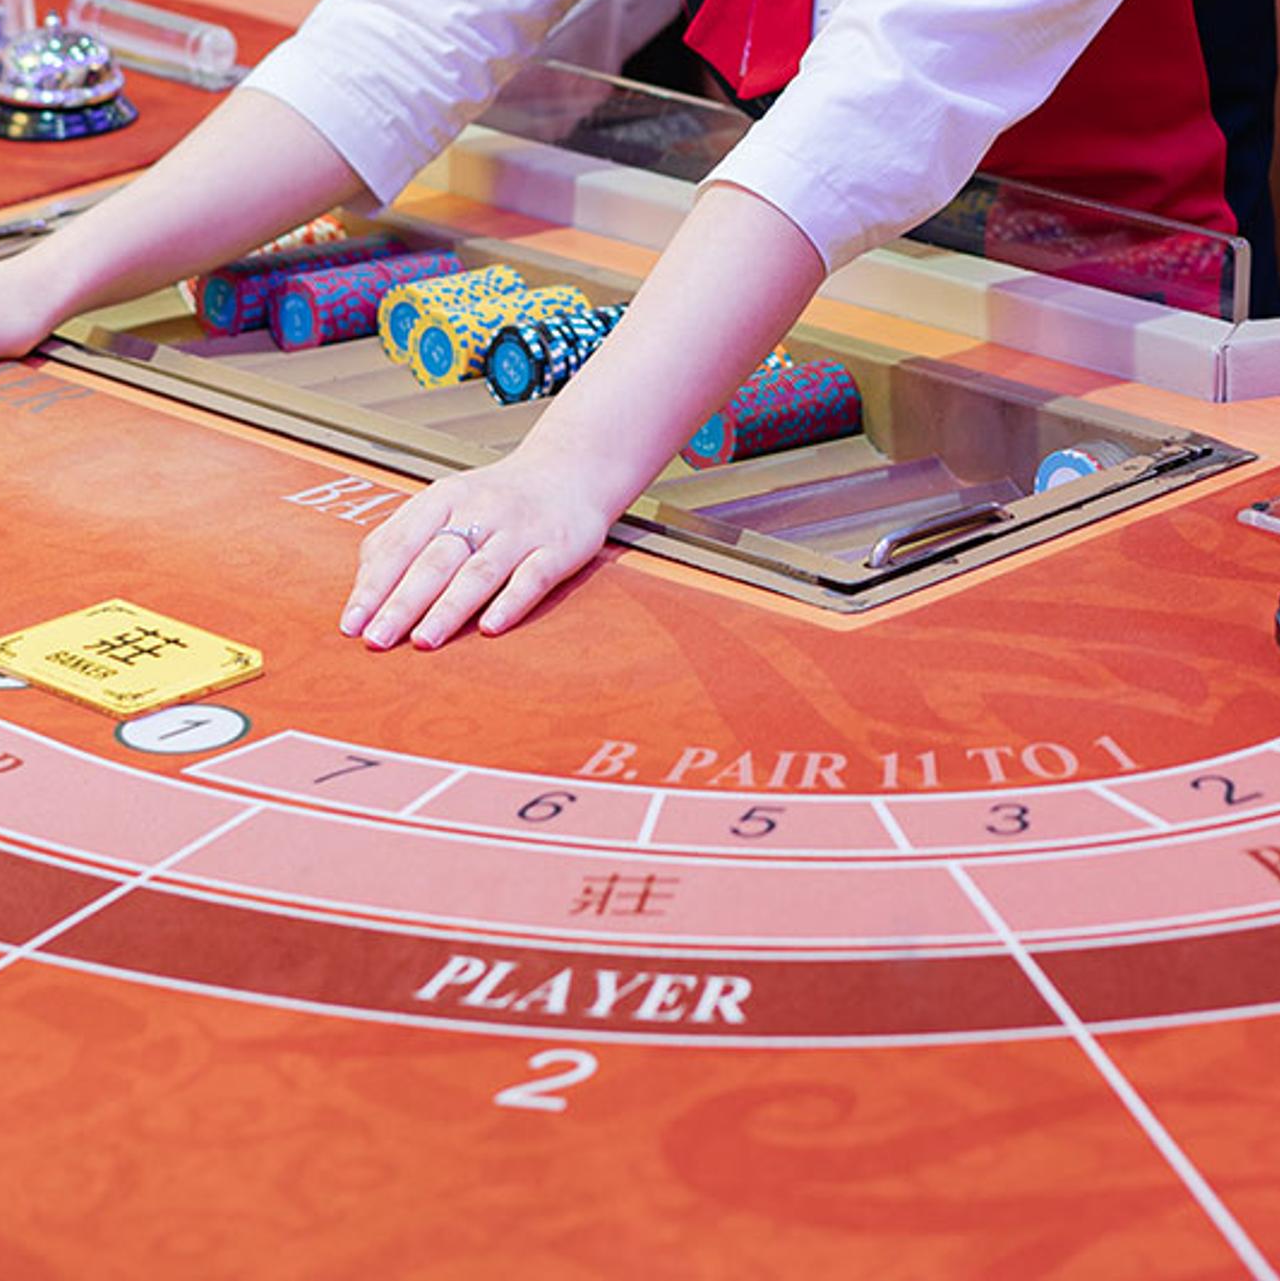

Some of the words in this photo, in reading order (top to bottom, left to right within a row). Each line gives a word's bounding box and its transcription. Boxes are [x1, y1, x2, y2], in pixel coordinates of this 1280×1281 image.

[82, 626, 189, 666] 莊
[45, 651, 118, 681] BANKER
[158, 719, 213, 741] 1
[313, 754, 381, 785] 7
[576, 738, 638, 782] B.
[663, 746, 848, 789] PAIR
[880, 751, 941, 789] 11
[967, 741, 1080, 783] TO
[1094, 735, 1141, 771] 1
[517, 790, 578, 823] 6
[1190, 773, 1265, 807] 2
[730, 806, 787, 838] 5
[984, 803, 1030, 836] 3
[568, 873, 681, 917] 莊
[413, 953, 753, 1024] PLAYER
[493, 1048, 599, 1113] 2
